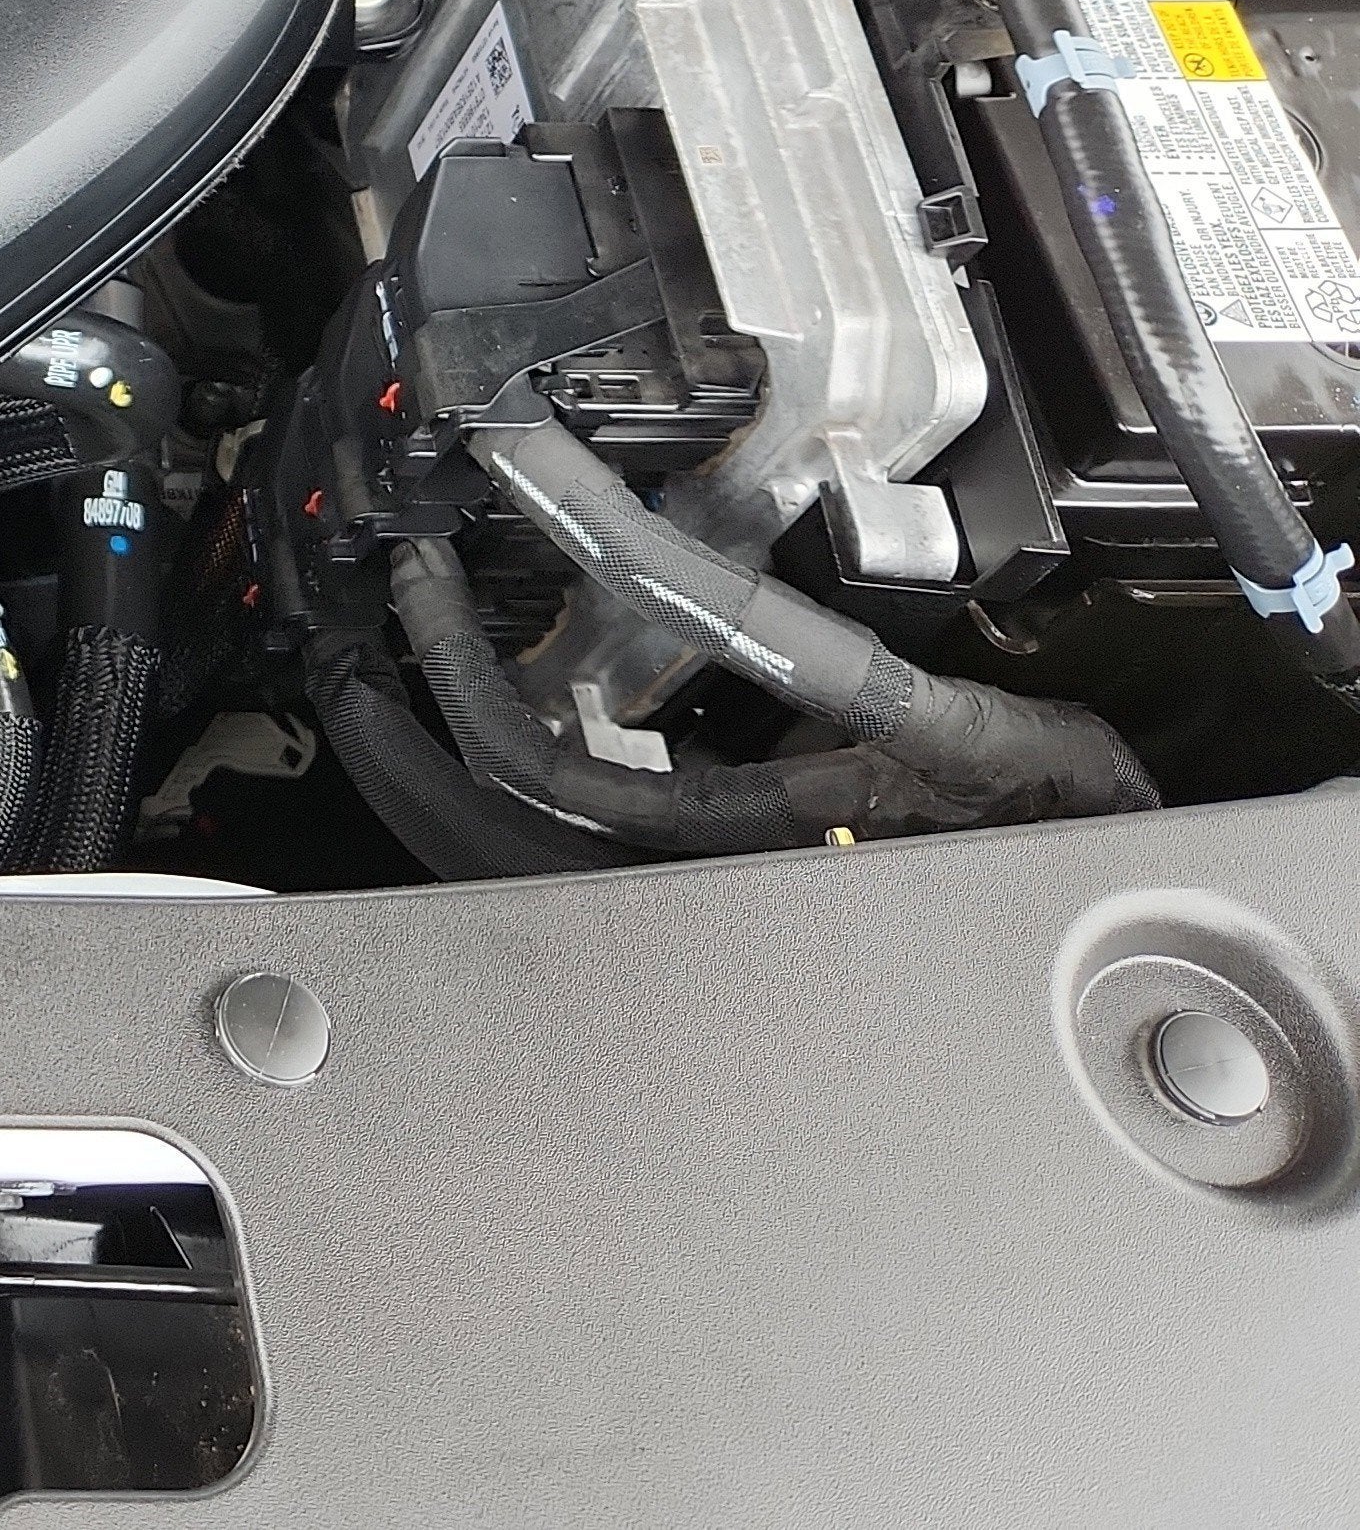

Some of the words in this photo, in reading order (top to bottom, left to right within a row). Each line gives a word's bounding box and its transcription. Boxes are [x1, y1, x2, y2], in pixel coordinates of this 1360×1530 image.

[1124, 15, 1152, 48] CAUSER
[1151, 41, 1171, 58] DES
[1141, 51, 1164, 73] PEUT
[1166, 94, 1196, 135] FLAMMES
[1195, 90, 1230, 139] IMMEDIATELY
[1236, 116, 1255, 135] HELP
[1148, 126, 1180, 159] ÉVITER
[1174, 138, 1192, 153] LES
[1187, 138, 1205, 153] LES
[1220, 141, 1240, 158] EYES
[1246, 137, 1273, 168] MEDICAL
[1230, 160, 1253, 184] FLUSH
[1246, 165, 1267, 184] WITH
[1263, 170, 1281, 184] GET
[1275, 166, 1296, 183] YEUX
[1294, 173, 1310, 183] UN
[1285, 185, 1303, 197] LES
[1206, 182, 1237, 224] PEUVENT
[1292, 199, 1316, 223] RINCEZ
[1300, 185, 1330, 223] CONSULTEZ
[1195, 228, 1213, 240] OR
[1207, 218, 1234, 249] YEUX.
[1226, 226, 1266, 282] EXPLOSIFS
[1242, 229, 1272, 266] RENDRE
[1286, 247, 1299, 255] BE
[1305, 233, 1330, 267] BATTERIE
[1170, 240, 1211, 296] EXPLOSIVE
[1189, 244, 1214, 274] CAUSE
[1203, 243, 1240, 296] BLINDNESS
[1223, 252, 1245, 271] LES
[1274, 246, 1299, 278] BATTERY
[1291, 258, 1310, 278] MUST
[1330, 261, 1347, 278] DOIT
[1262, 270, 1279, 282] OU
[1323, 268, 1336, 278] LA
[1205, 277, 1225, 296] CAN
[1254, 285, 1277, 306] GAZ
[1231, 274, 1273, 328] PROTÉGEZ
[1270, 285, 1301, 328] BLESSER
[1326, 298, 1344, 312] Pb
[1266, 310, 1288, 328] LES
[50, 329, 82, 357] UPR
[43, 357, 79, 388] PIPE
